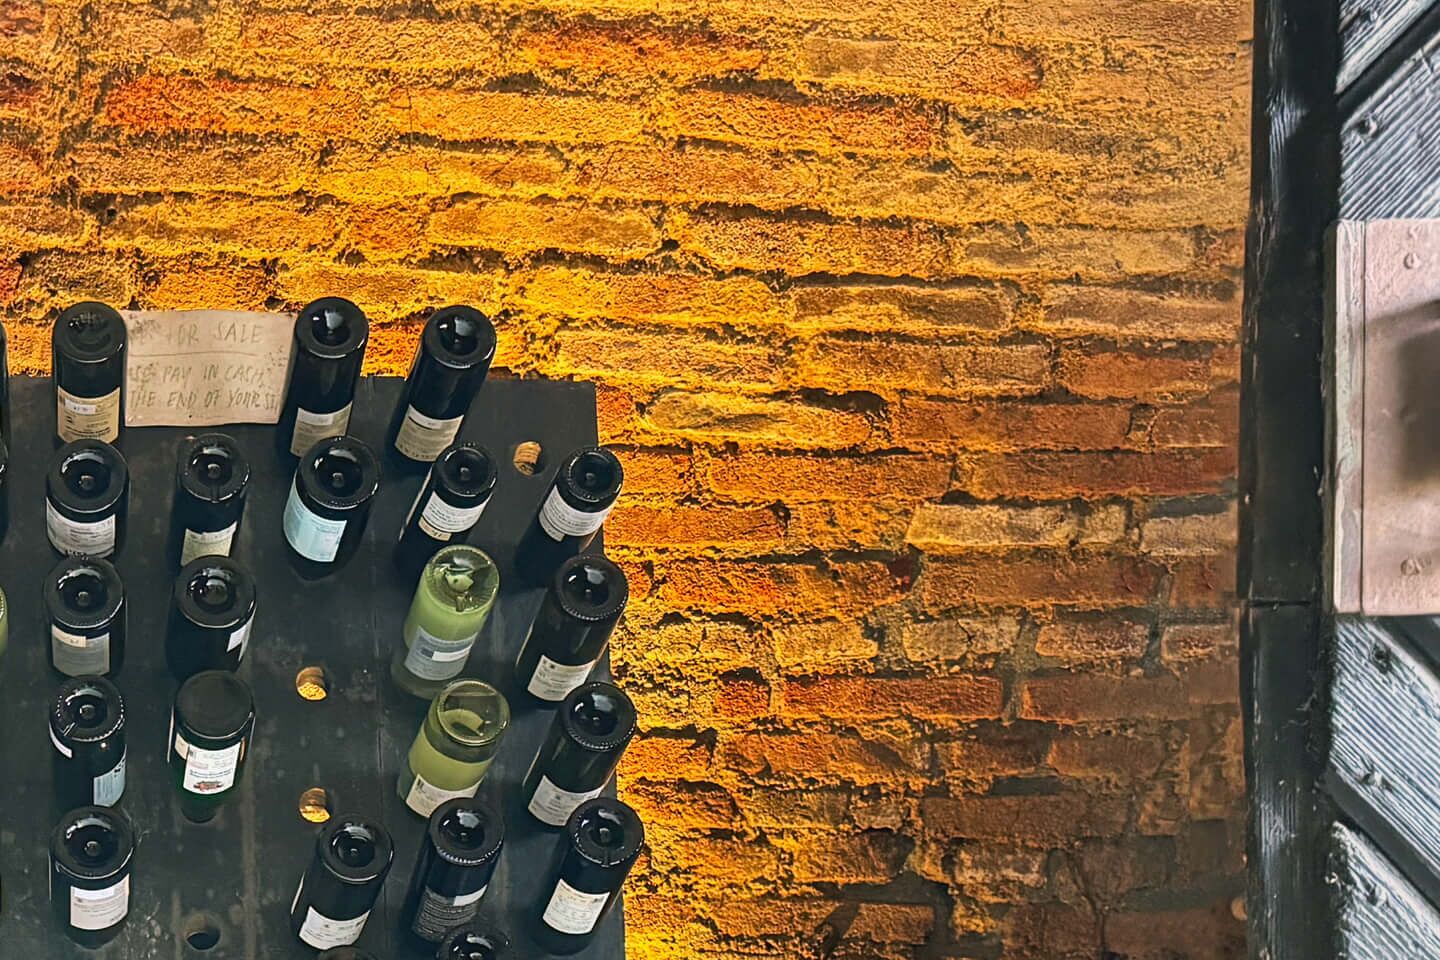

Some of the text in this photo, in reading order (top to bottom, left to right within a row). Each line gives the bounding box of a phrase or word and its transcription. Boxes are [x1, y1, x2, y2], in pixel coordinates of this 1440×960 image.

[213, 322, 264, 345] SALE
[163, 364, 192, 388] PAY
[203, 363, 220, 381] IN
[129, 389, 156, 410] THE
[167, 390, 197, 409] END
[204, 389, 221, 408] OF
